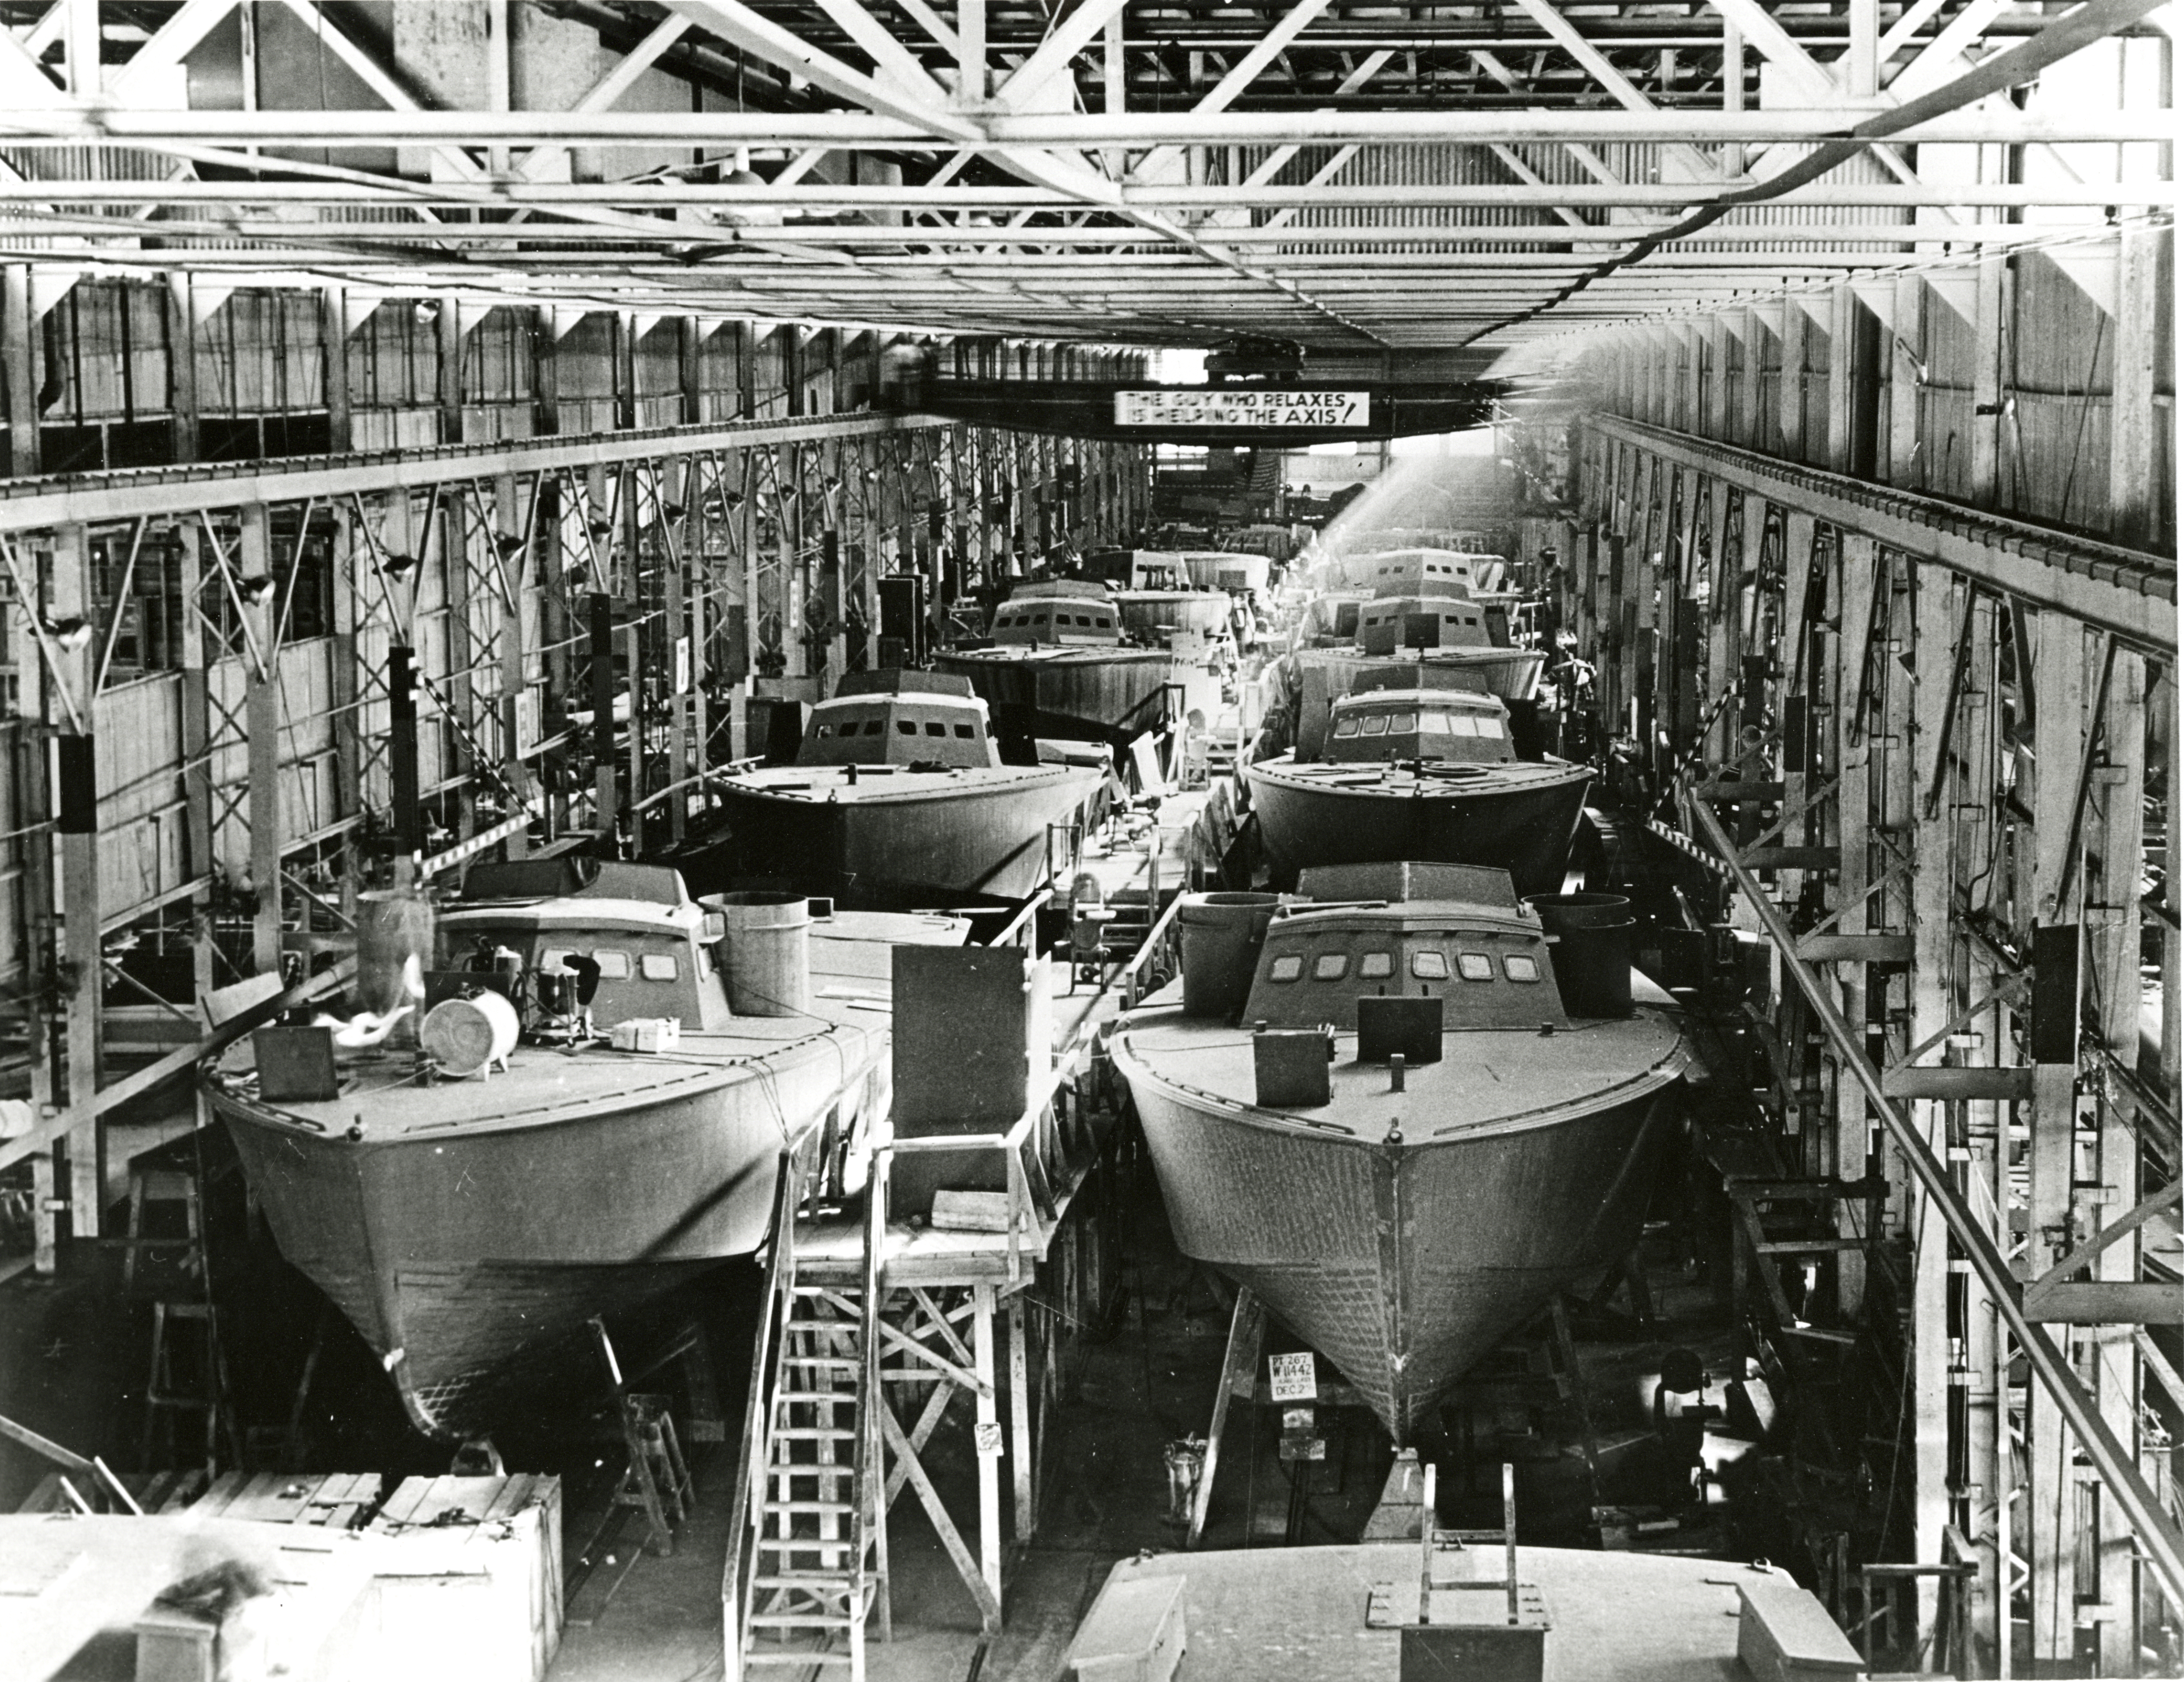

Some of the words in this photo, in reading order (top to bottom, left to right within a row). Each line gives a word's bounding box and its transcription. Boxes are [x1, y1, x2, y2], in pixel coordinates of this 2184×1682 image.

[1223, 393, 1257, 406] WHO
[1264, 393, 1345, 407] RELAXES
[1245, 409, 1277, 423] THE
[1285, 402, 1357, 423] AXIS!
[1273, 1357, 1283, 1365] PT
[1287, 1355, 1306, 1364] 267
[1276, 1385, 1295, 1395] DEC
